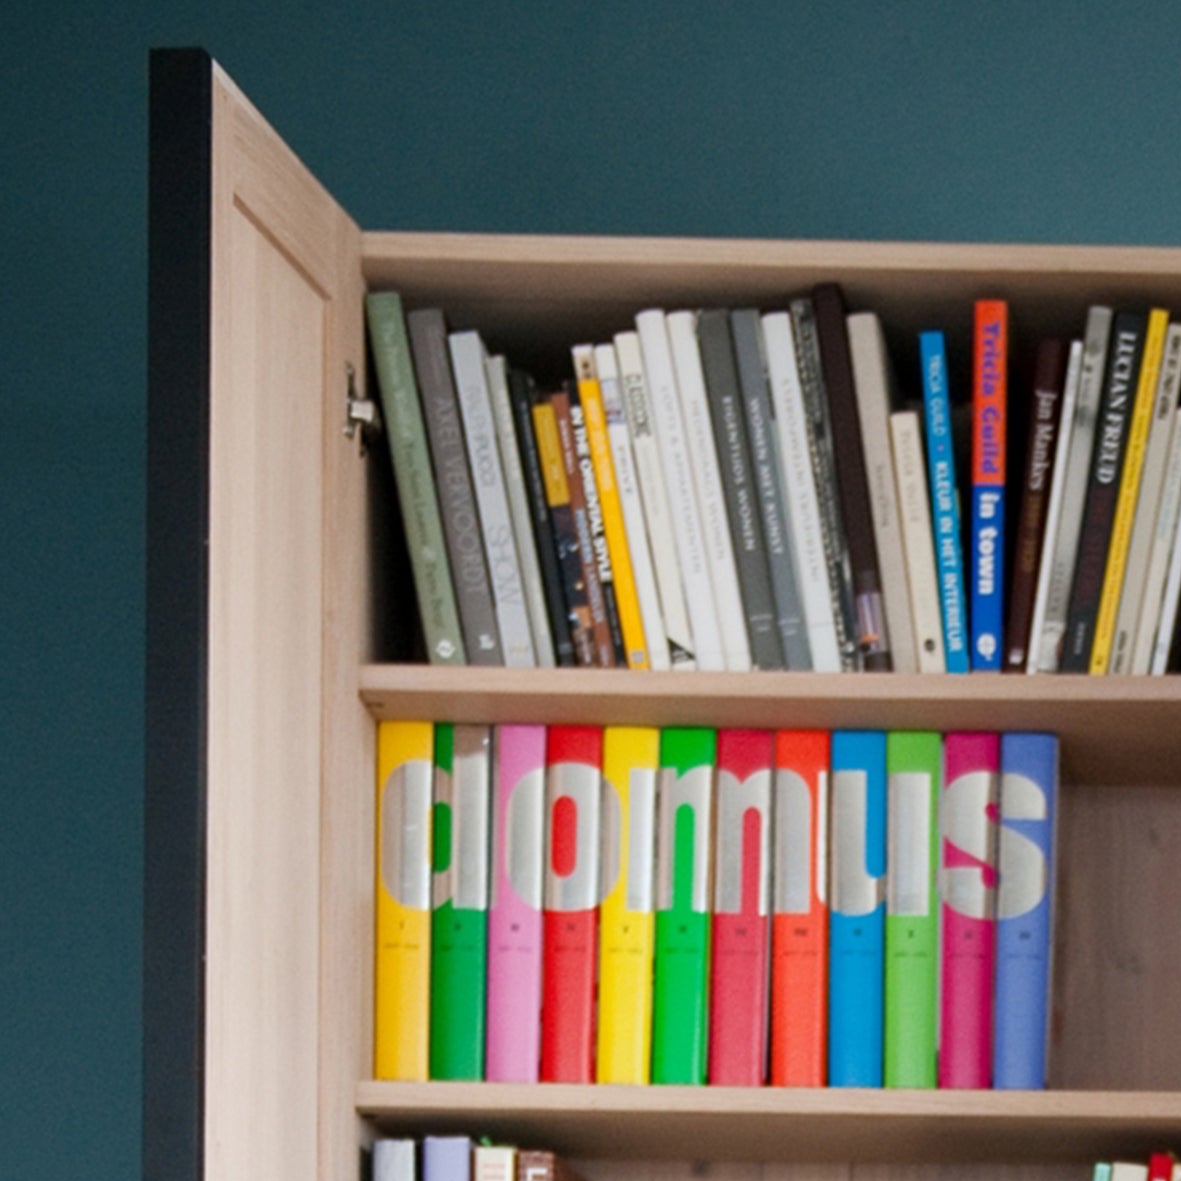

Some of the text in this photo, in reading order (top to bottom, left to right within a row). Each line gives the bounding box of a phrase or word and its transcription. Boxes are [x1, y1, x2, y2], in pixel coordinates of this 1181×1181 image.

[980, 320, 999, 394] Tricia
[1107, 330, 1135, 409] LUCIAN
[433, 396, 459, 446] AXEL
[979, 405, 999, 473] Guild
[1034, 390, 1056, 419] Jan
[573, 427, 590, 455] THE
[748, 398, 784, 554] WONEN MET KUNST
[1027, 423, 1052, 490] Mankes
[1096, 412, 1123, 483] FREUD
[444, 460, 482, 593] VERVOORDT
[578, 459, 603, 534] ORIENTAL
[735, 489, 756, 550] WONEN
[926, 354, 961, 651] TRICIA GUILD KLEUR IN HET INTERIEUR
[488, 525, 520, 604] SHOW
[590, 536, 611, 581] STYLE
[978, 527, 997, 594] town
[380, 759, 1047, 919] domus
